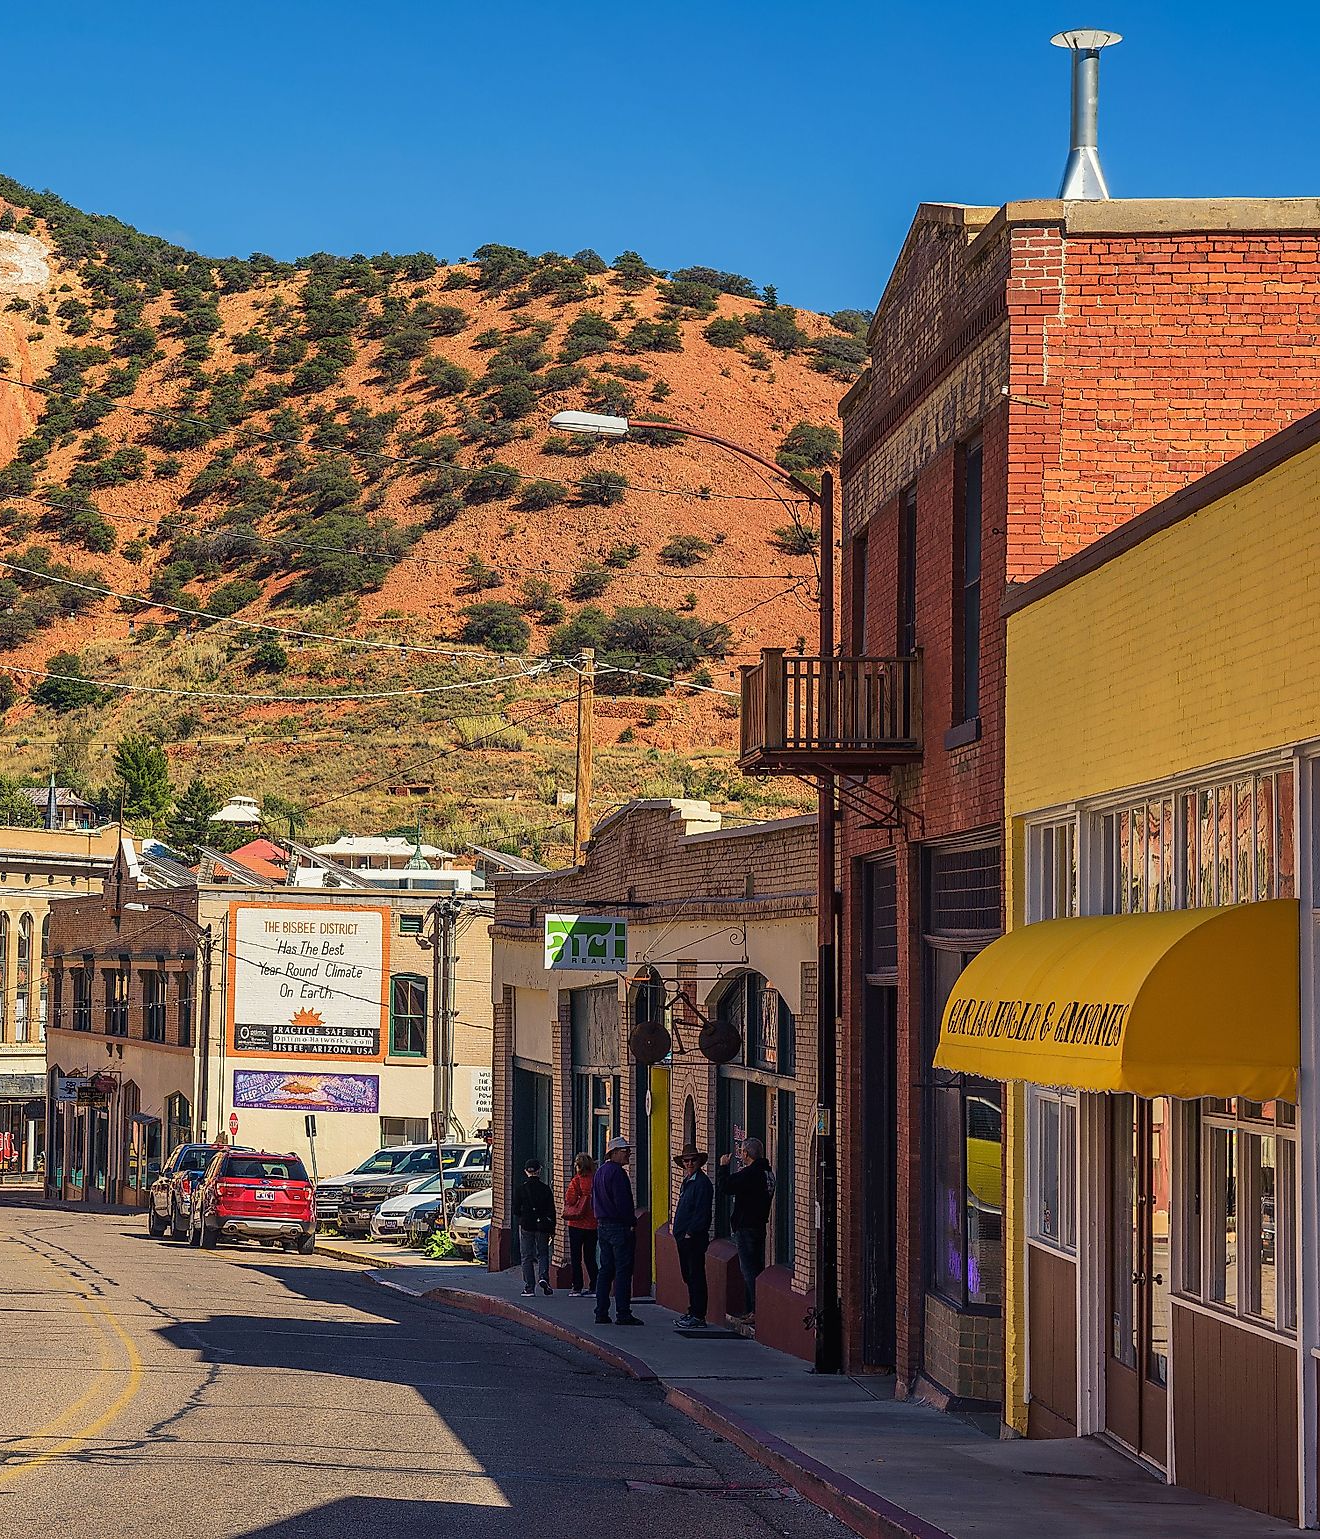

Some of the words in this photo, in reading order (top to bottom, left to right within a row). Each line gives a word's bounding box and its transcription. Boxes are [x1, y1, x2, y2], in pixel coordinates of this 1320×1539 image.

[264, 921, 280, 932] THE
[283, 921, 316, 934] BISBEE
[320, 922, 358, 935] DISTRICT
[277, 940, 297, 954] Has
[300, 941, 318, 955] The
[321, 941, 345, 956] Best
[259, 961, 281, 976] Year
[286, 962, 319, 977] Round
[325, 963, 362, 978] Climate
[280, 983, 293, 998] On
[300, 984, 334, 999] Earth.
[1039, 1001, 1056, 1041] &
[272, 1026, 319, 1034] PRACTICE
[325, 1028, 347, 1036] SAFE
[353, 1029, 374, 1037] SUN
[272, 1044, 307, 1053] BISBEE,
[312, 1045, 351, 1054] ARIZONA
[357, 1047, 373, 1055] USA
[236, 1073, 269, 1090] LAVENDER
[240, 1089, 257, 1102] JEEP
[257, 1075, 284, 1095] TOURS
